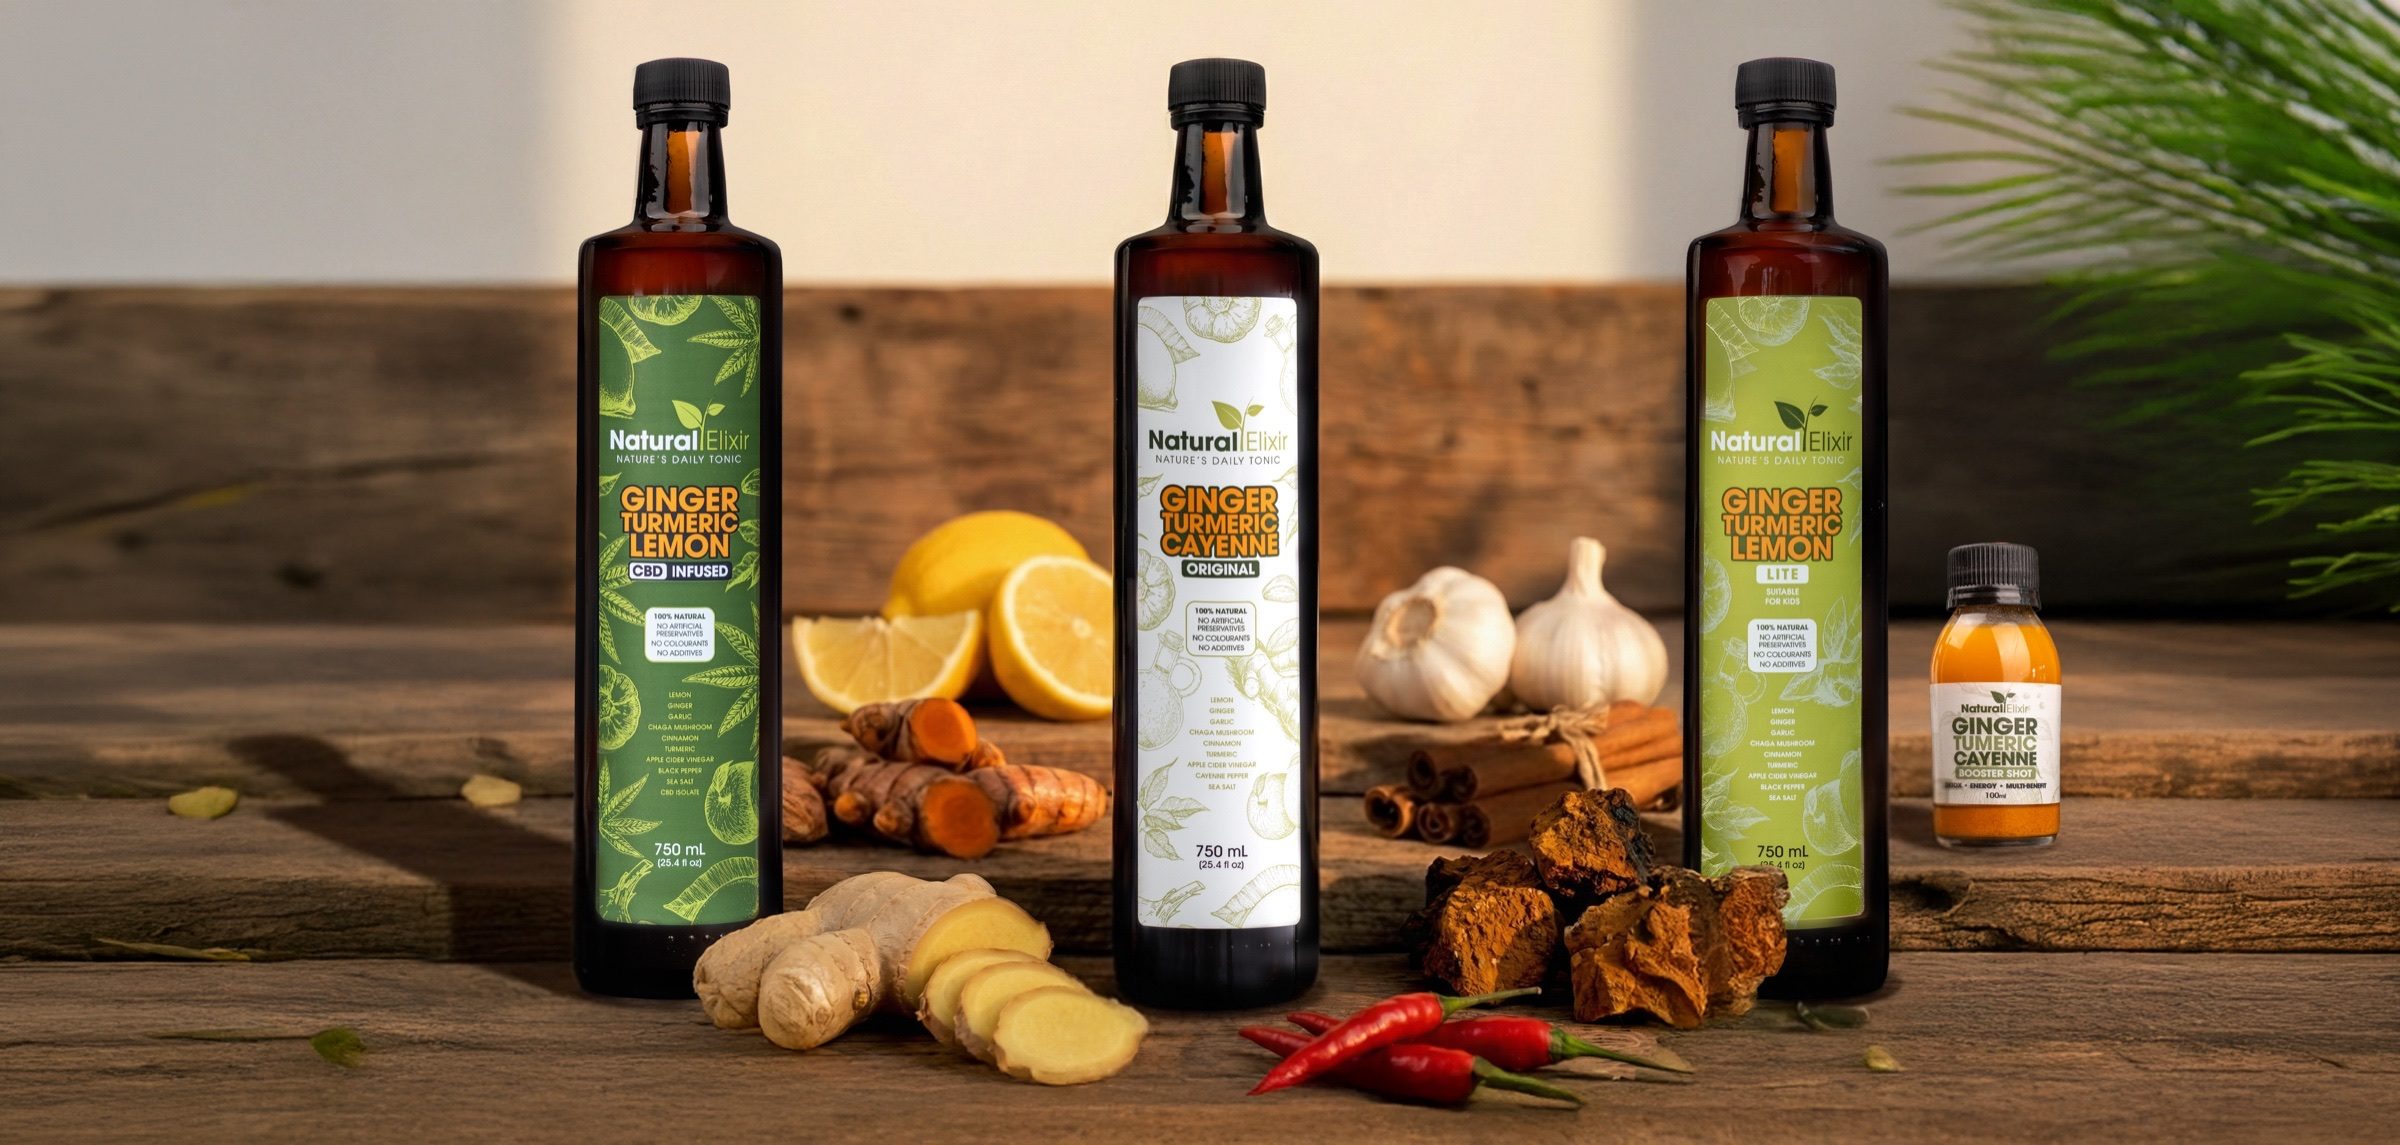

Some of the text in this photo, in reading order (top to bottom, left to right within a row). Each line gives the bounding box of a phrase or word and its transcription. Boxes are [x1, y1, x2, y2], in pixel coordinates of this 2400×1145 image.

[610, 429, 749, 451] Natural Elixir
[1149, 430, 1288, 451] Natural Elixir
[1711, 430, 1852, 452] Natural Elixir
[616, 455, 742, 464] NATURE'S DAILY TONIC
[1155, 455, 1281, 465] NATURE'S DAILY TONIC
[1718, 456, 1845, 464] NATURE'S DAILY TONIC
[621, 486, 738, 512] GINGER
[1160, 485, 1278, 513] GINGER
[1722, 487, 1842, 515] GINGER
[621, 512, 738, 533] TURMERIC
[1161, 512, 1278, 534] TURMERIC
[1722, 514, 1842, 536] TURMERIC
[630, 533, 729, 558] LEMON
[1161, 533, 1279, 557] CAYENNE
[1732, 536, 1833, 561] LEMON
[632, 565, 729, 578] CBD INFUSED
[1186, 563, 1255, 576] ORIGINAL
[1767, 568, 1798, 580] LITE
[1961, 704, 2028, 713] Natural Elixir
[1952, 717, 2038, 735] GINGER
[1953, 736, 2036, 750] TUMERIC
[1954, 751, 2036, 766] CAYENNE
[1960, 769, 2032, 778] BOOSTER SHOT
[655, 843, 706, 856] 750 mL
[1196, 845, 1248, 857] 750 mL
[1757, 845, 1808, 857] 750 mL
[658, 859, 679, 868] (25.4
[690, 859, 702, 868] oz)
[1199, 861, 1221, 870] (25.4
[1232, 861, 1244, 870] oz)
[1792, 861, 1805, 869] oz)
